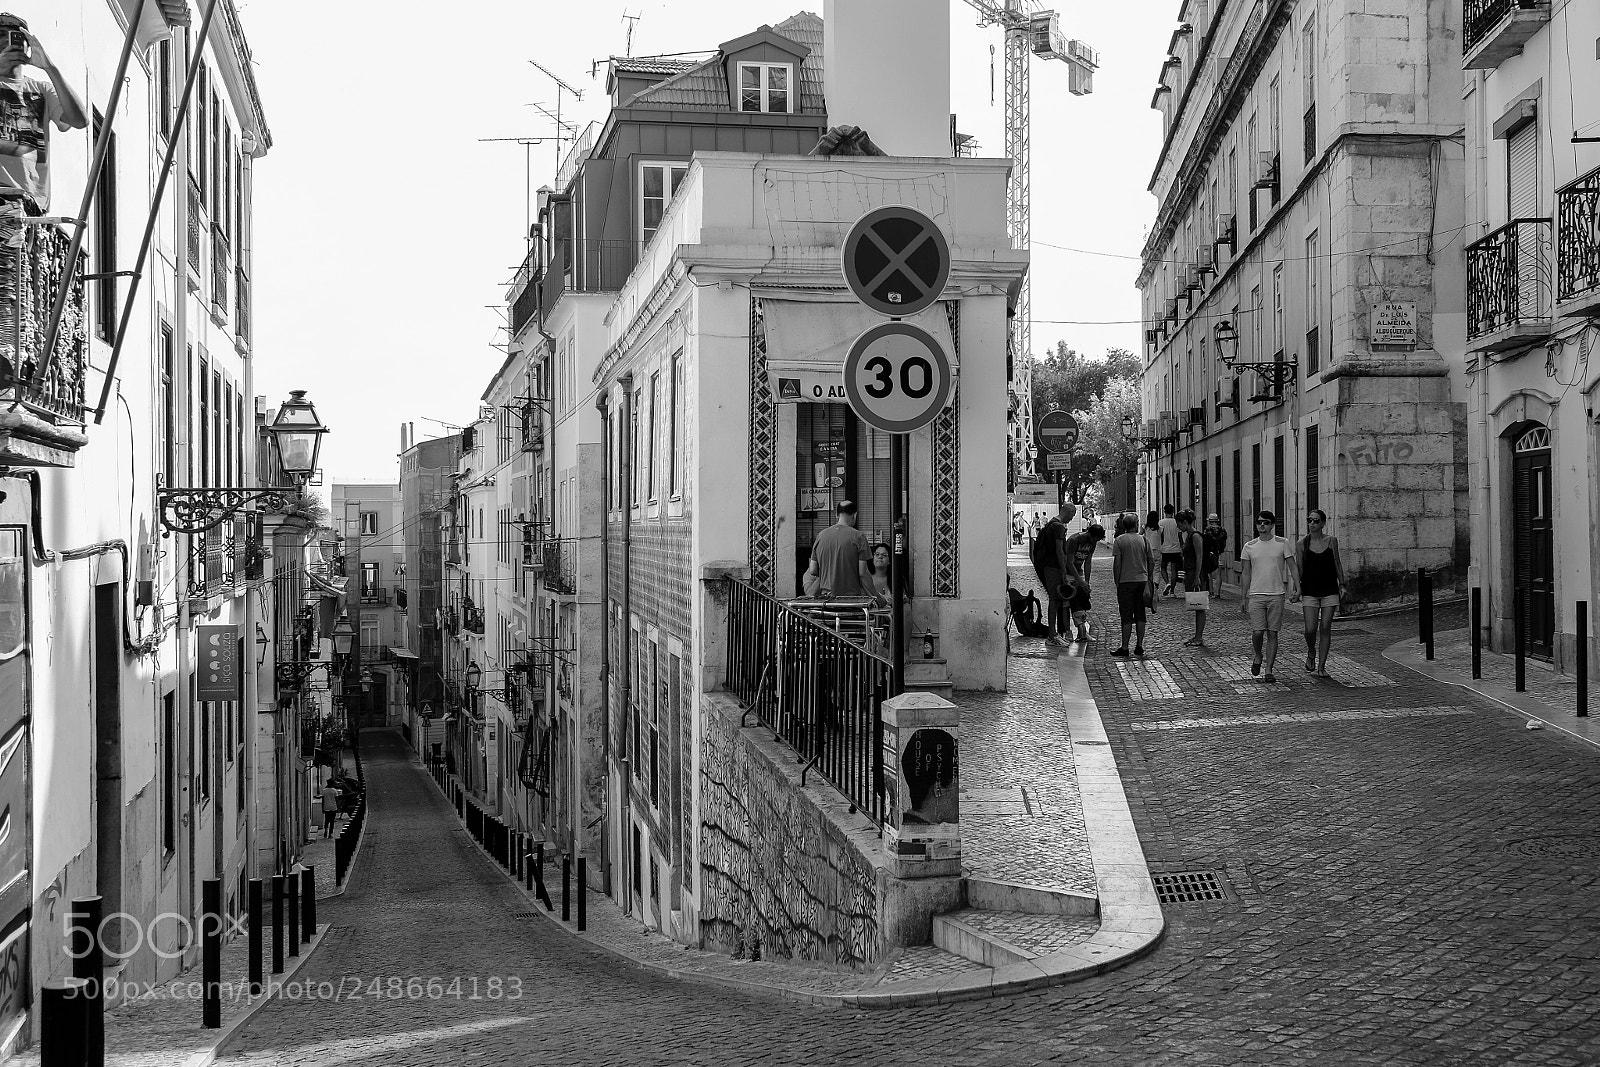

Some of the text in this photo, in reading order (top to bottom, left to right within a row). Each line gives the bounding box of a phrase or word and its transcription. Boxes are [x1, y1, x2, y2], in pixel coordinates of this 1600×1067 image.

[813, 385, 823, 397] O
[864, 357, 932, 399] 30
[914, 731, 922, 777] HOUSE
